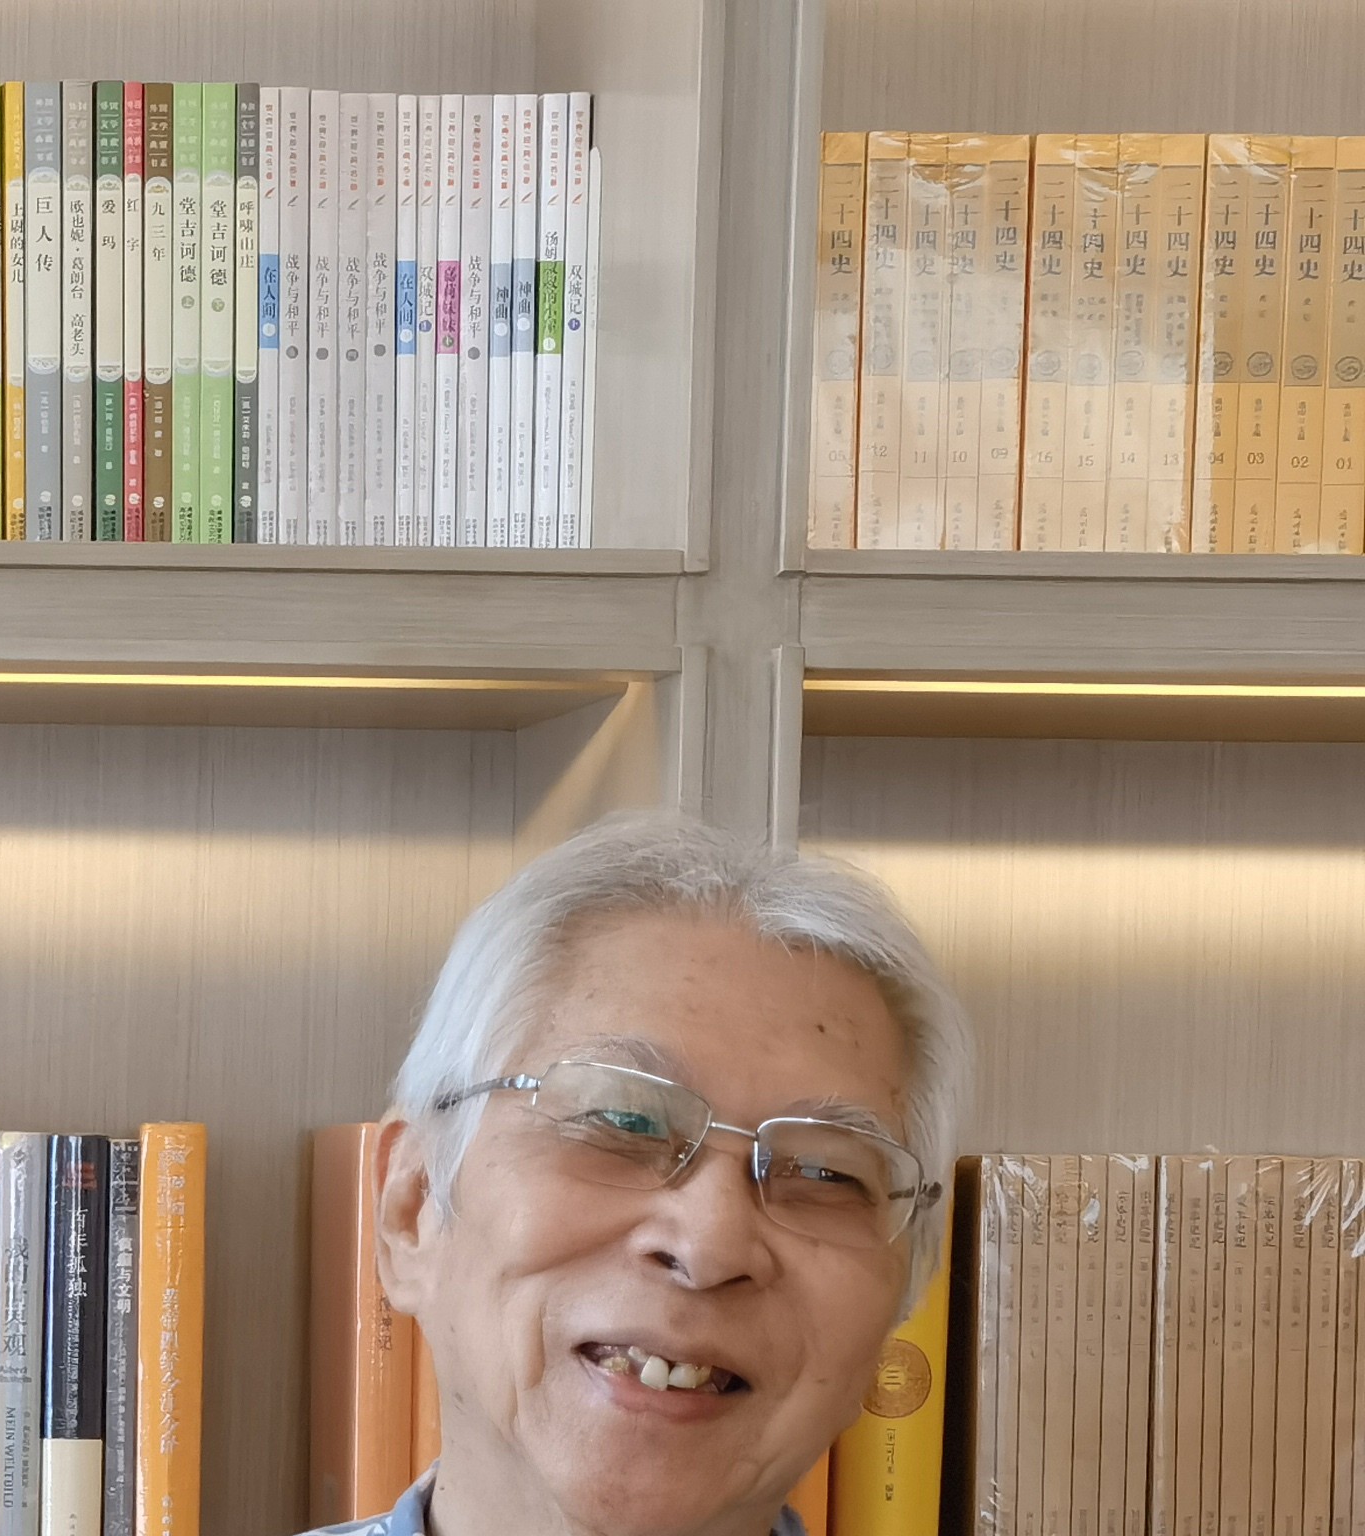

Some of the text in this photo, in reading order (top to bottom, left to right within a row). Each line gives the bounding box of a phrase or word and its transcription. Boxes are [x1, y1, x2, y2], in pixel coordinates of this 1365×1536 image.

[35, 196, 53, 273] 巨人传
[101, 199, 117, 250] 爱玛
[151, 201, 167, 262] 九三年
[178, 197, 198, 284] 堂吉诃德
[209, 199, 229, 286] 堂吉诃德
[238, 200, 255, 269] 呼啸山庄
[830, 179, 855, 276] 二十四史
[873, 175, 899, 271] 二十四史
[952, 180, 981, 276] 二十四史
[994, 176, 1019, 273] 二十四史
[1039, 180, 1065, 277] 二十四史
[1125, 180, 1151, 276] 二十四史
[1167, 181, 1193, 277] 二十四史
[1213, 180, 1240, 276] 二十四史
[1253, 180, 1280, 276] 二十四史
[1299, 184, 1326, 281] 二十四史
[1342, 184, 1365, 282] 二十四史
[262, 266, 277, 319] 在人间
[284, 253, 301, 337] 战争与和平
[315, 256, 331, 339] 战争与和平
[345, 256, 362, 340] 战争与和平
[371, 251, 388, 336] 战争与和平
[398, 273, 414, 326] 在人间
[468, 255, 482, 339] 战争与和平
[495, 286, 510, 320] 神曲
[518, 280, 532, 315] 神曲
[568, 264, 583, 315] 双城记
[70, 312, 86, 357] 高老头
[68, 1208, 88, 1298] 百年孤独
